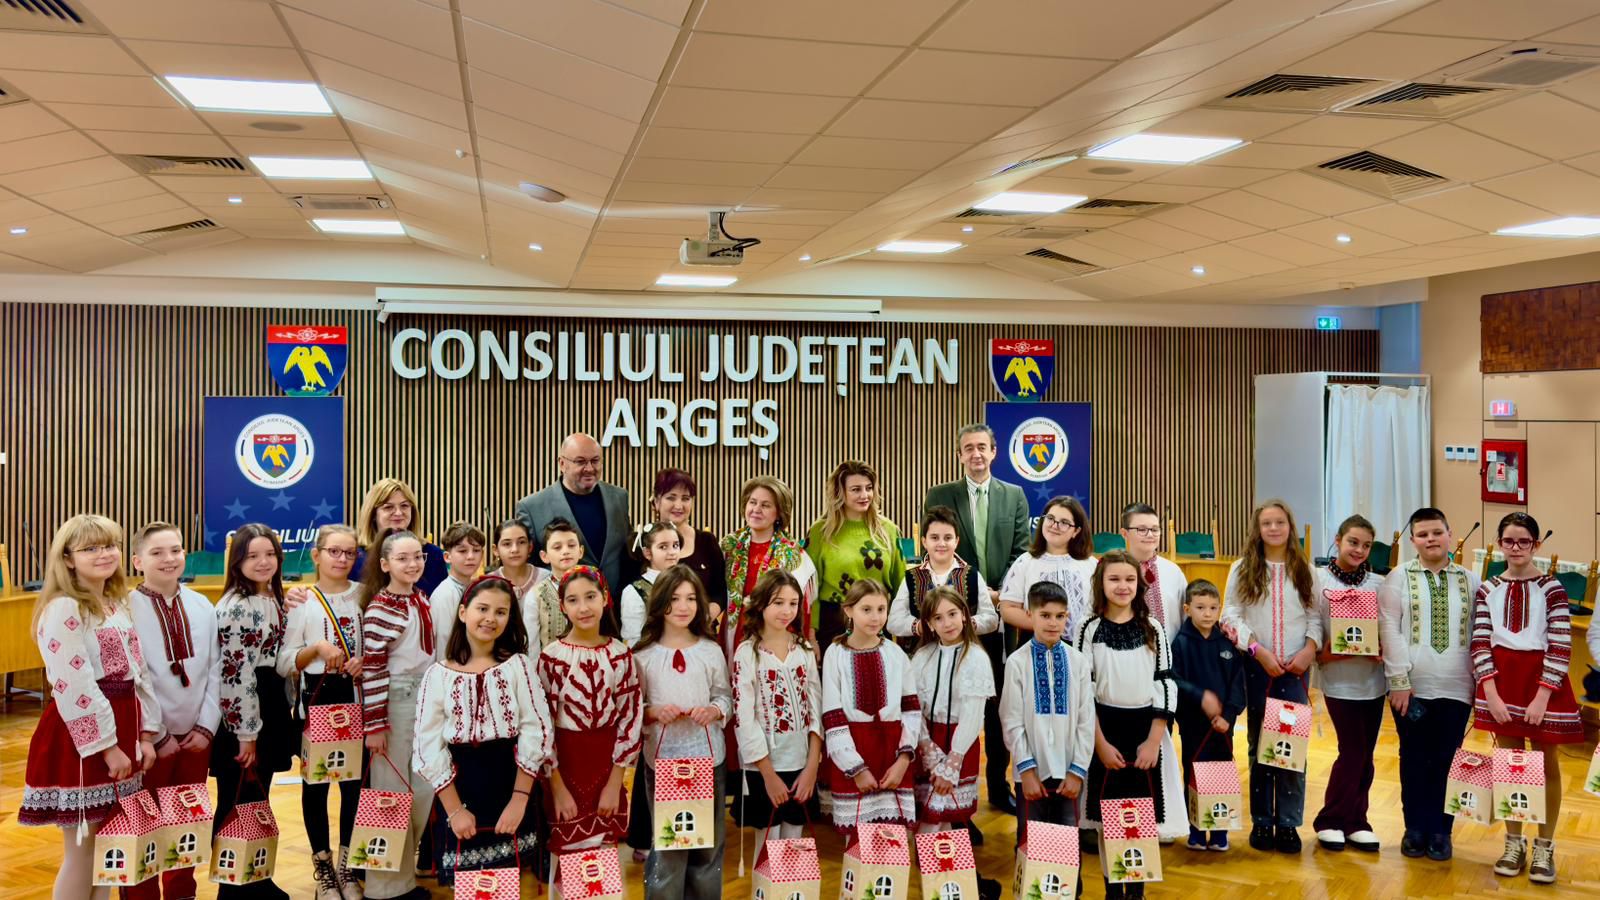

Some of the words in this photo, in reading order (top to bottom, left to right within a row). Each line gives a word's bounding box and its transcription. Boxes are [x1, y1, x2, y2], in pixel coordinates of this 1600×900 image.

[390, 328, 684, 382] CONSILIUL
[700, 335, 959, 396] JUDEȚEAN
[601, 397, 779, 460] ARGEȘ
